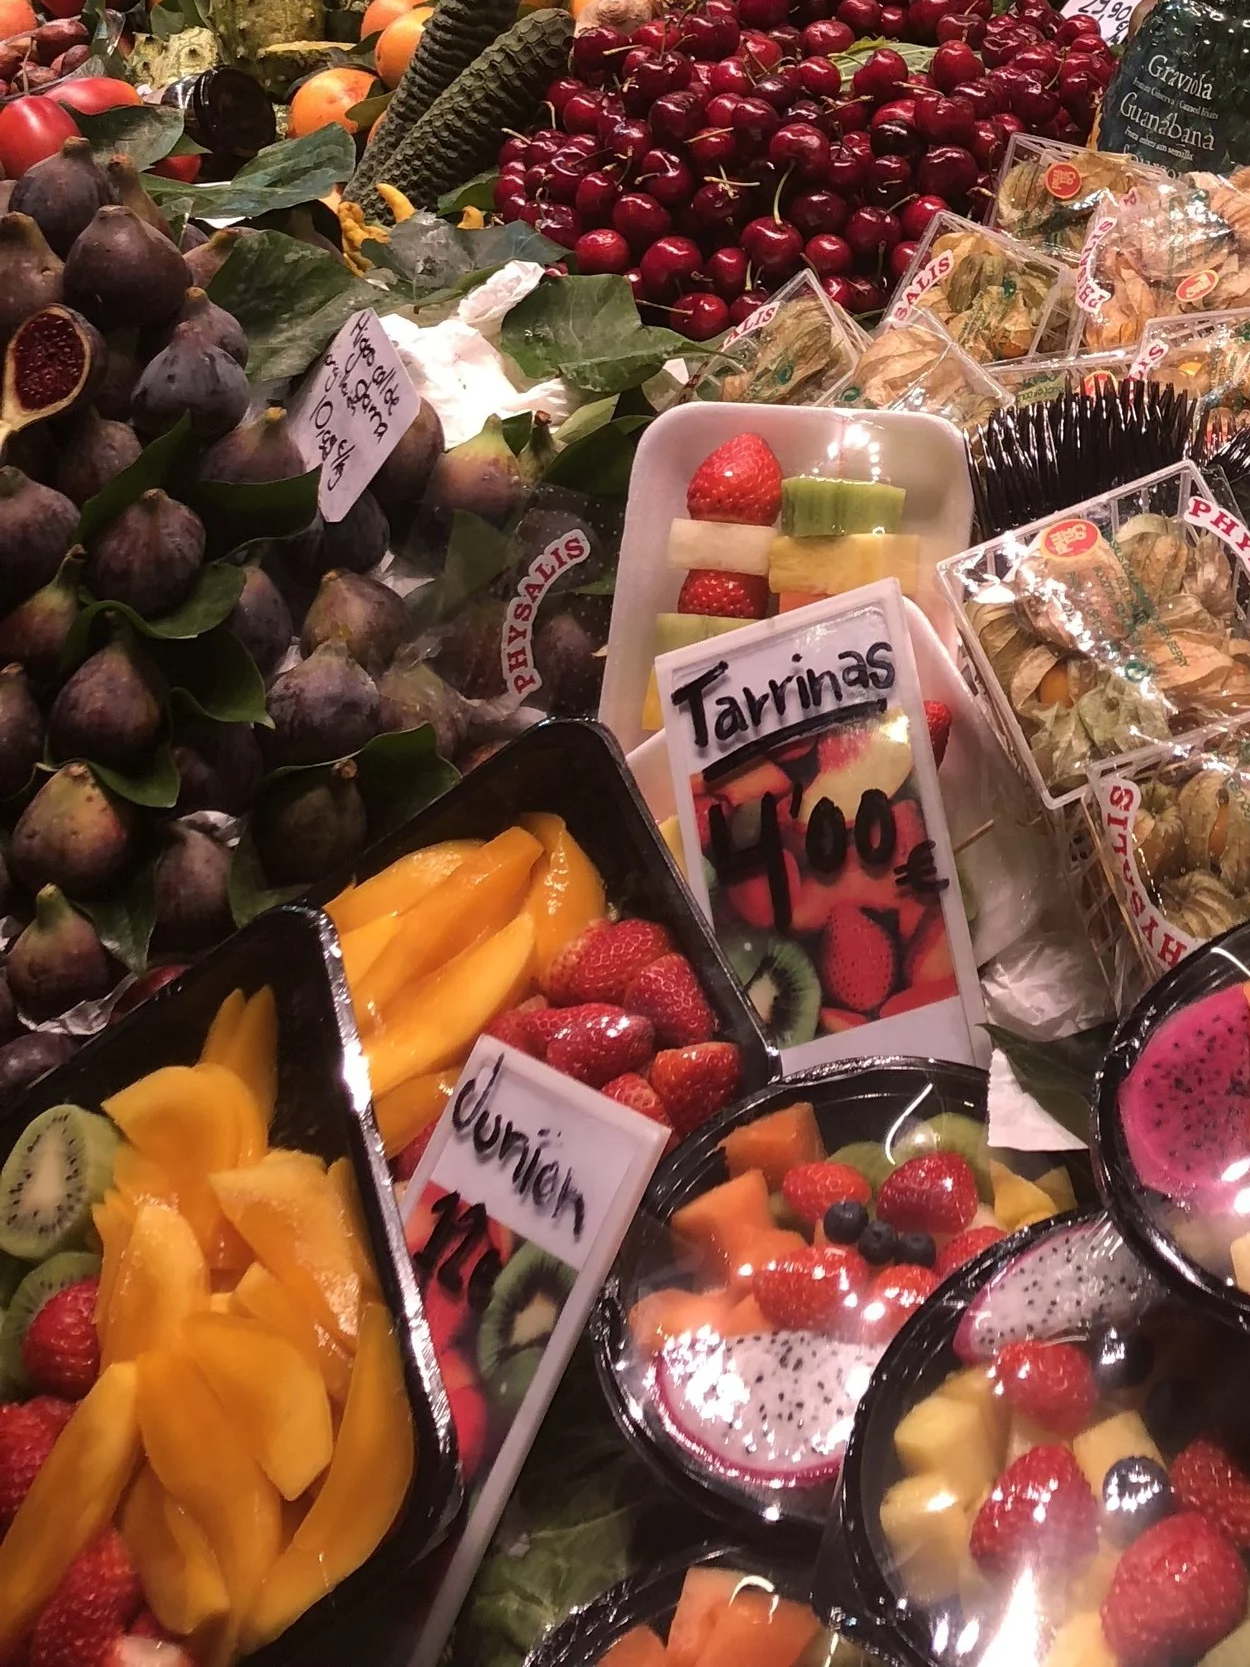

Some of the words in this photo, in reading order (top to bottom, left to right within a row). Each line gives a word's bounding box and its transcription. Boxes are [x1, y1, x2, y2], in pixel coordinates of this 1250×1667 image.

[1147, 53, 1213, 101] Graviola
[893, 255, 951, 321] SALIS
[724, 305, 776, 345] ALIS
[507, 536, 586, 695] PHYSALIS
[671, 640, 896, 751] Tarrinas
[893, 838, 950, 901] €
[1106, 784, 1188, 968] HYSALIS
